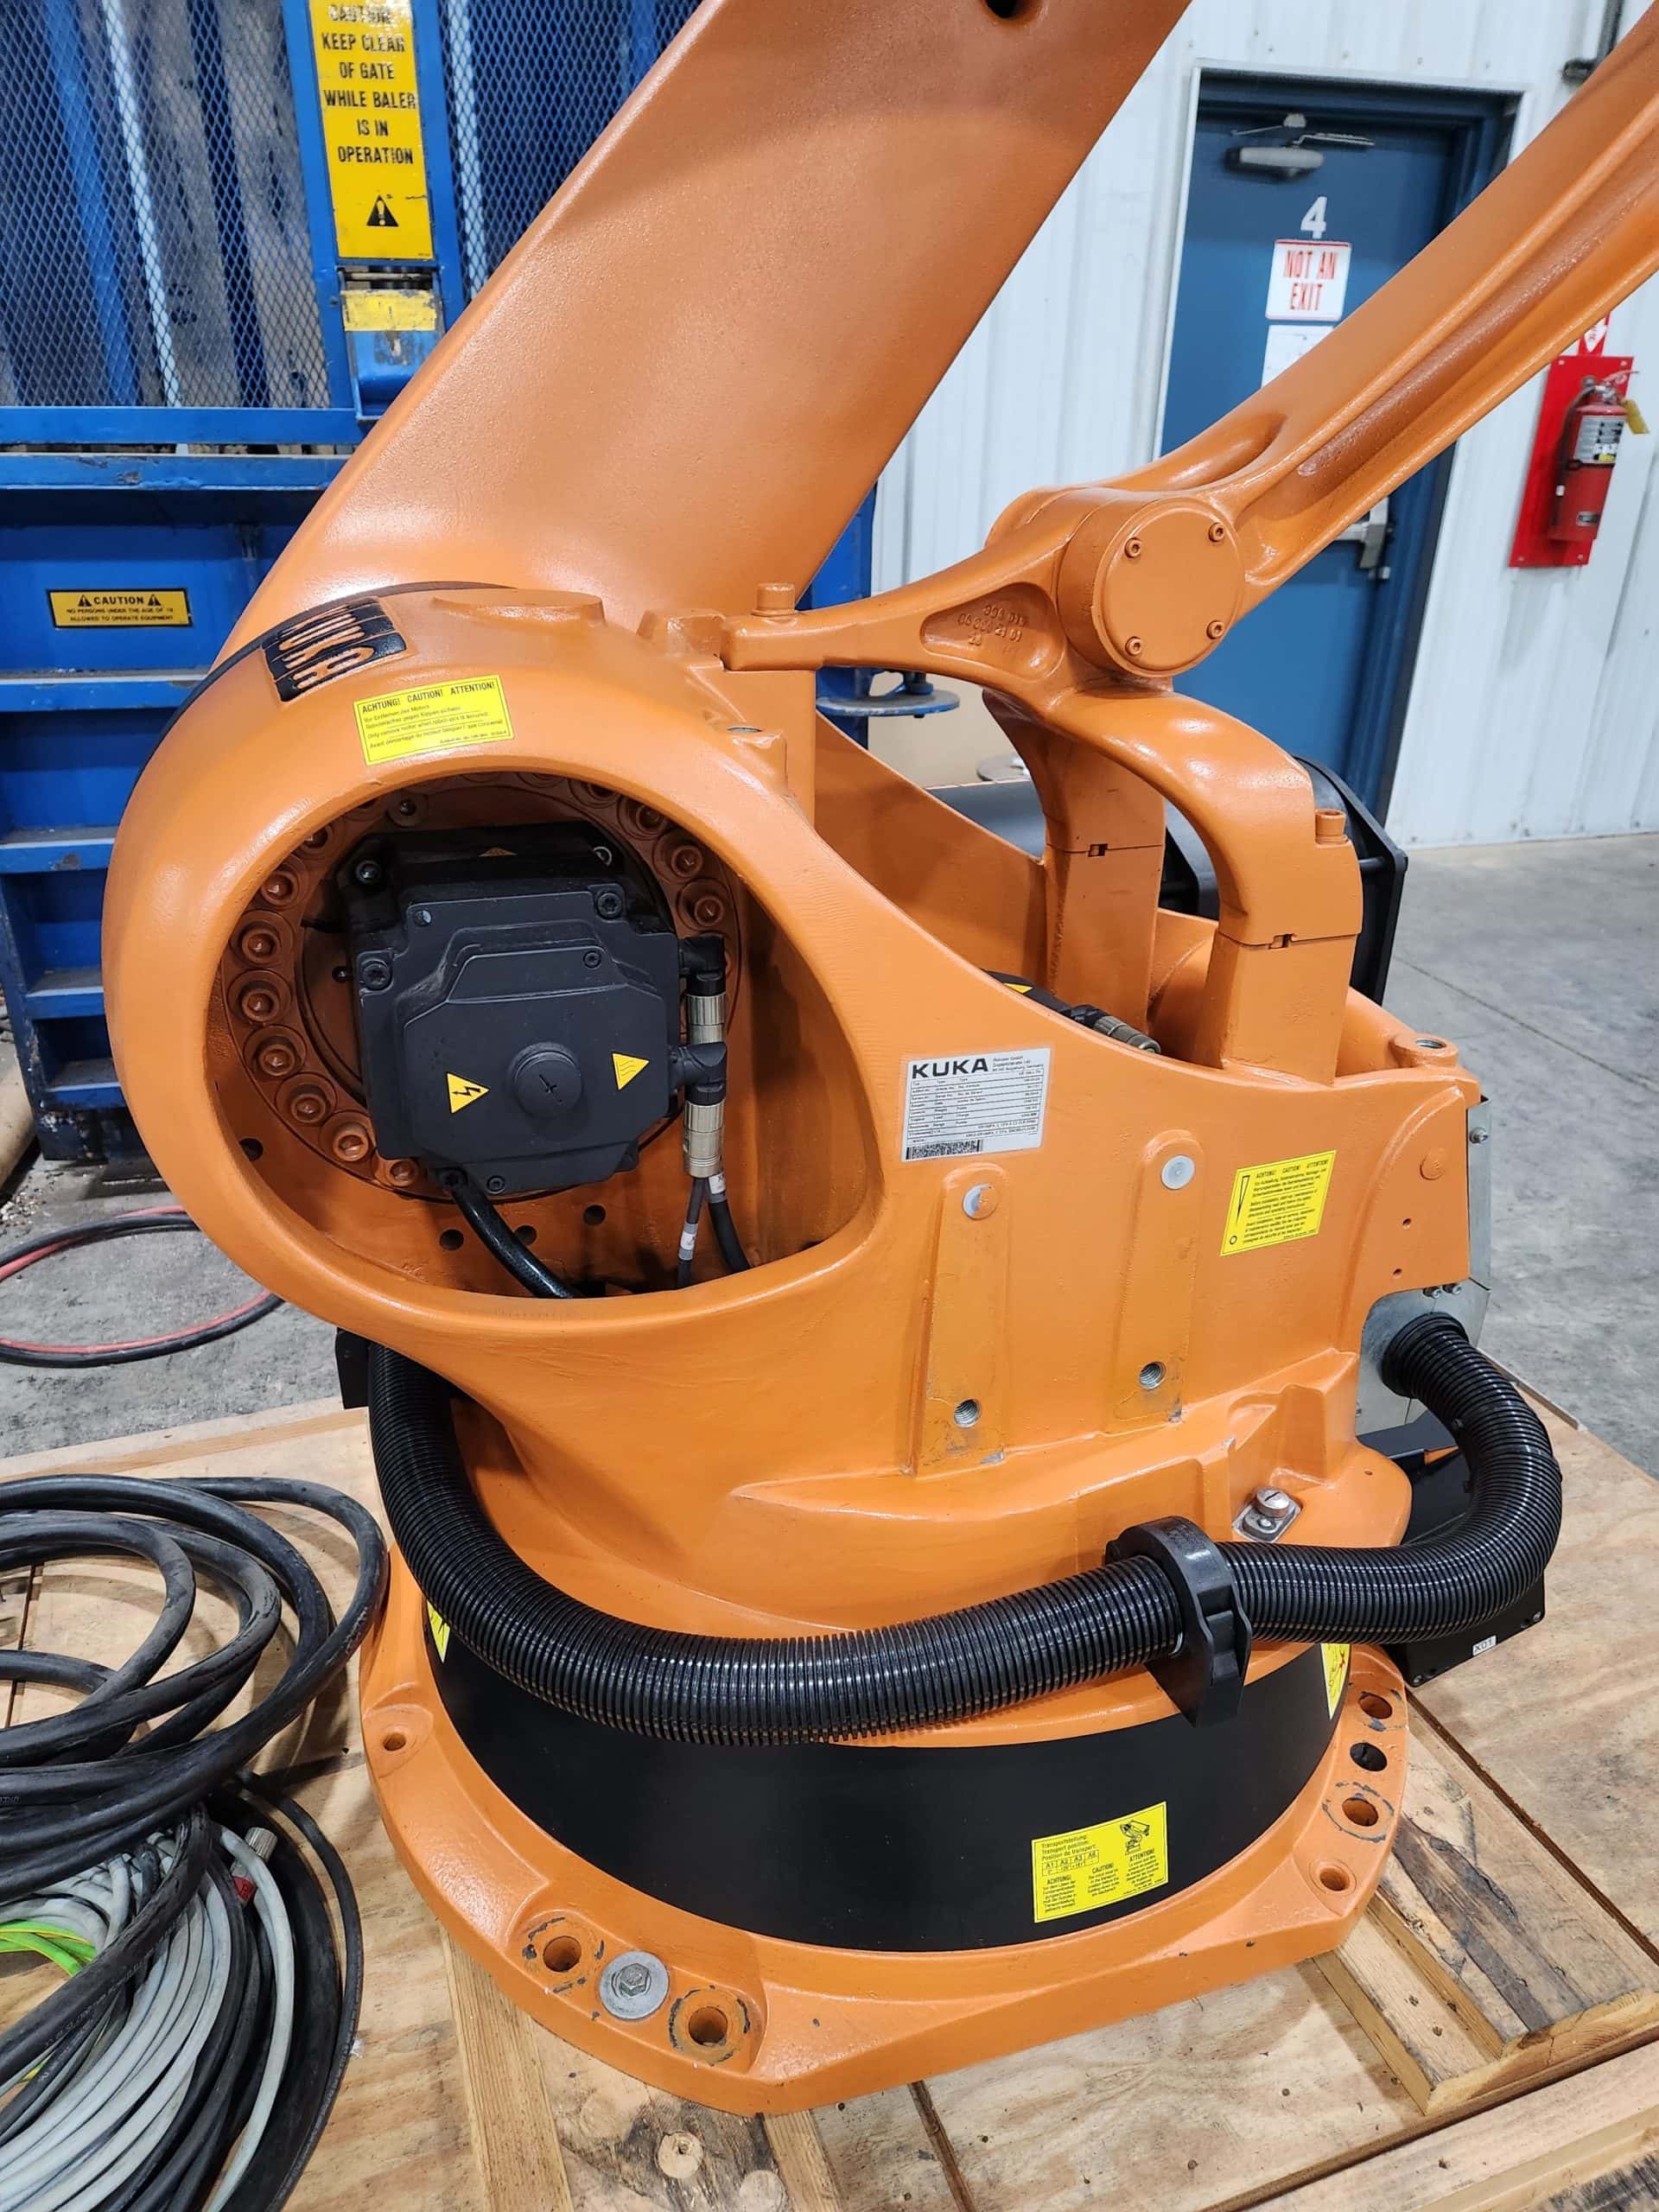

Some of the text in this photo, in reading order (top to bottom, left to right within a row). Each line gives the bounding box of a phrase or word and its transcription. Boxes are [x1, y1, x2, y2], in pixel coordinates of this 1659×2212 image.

[321, 32, 405, 52] KEEP CLEAR
[339, 61, 395, 79] OF GATE
[323, 90, 416, 109] WHILE BALER
[357, 118, 389, 137] IS IN
[337, 146, 414, 164] OPERATION
[1300, 196, 1328, 239] 4
[1283, 251, 1338, 279] NOT AN
[1288, 283, 1324, 311] EXIT
[93, 596, 144, 605] CAUTION
[277, 602, 375, 690] KUKA
[362, 681, 496, 713] ACHTUNG! CAUTION! ATTENTION!
[912, 1058, 988, 1079] KUKA
